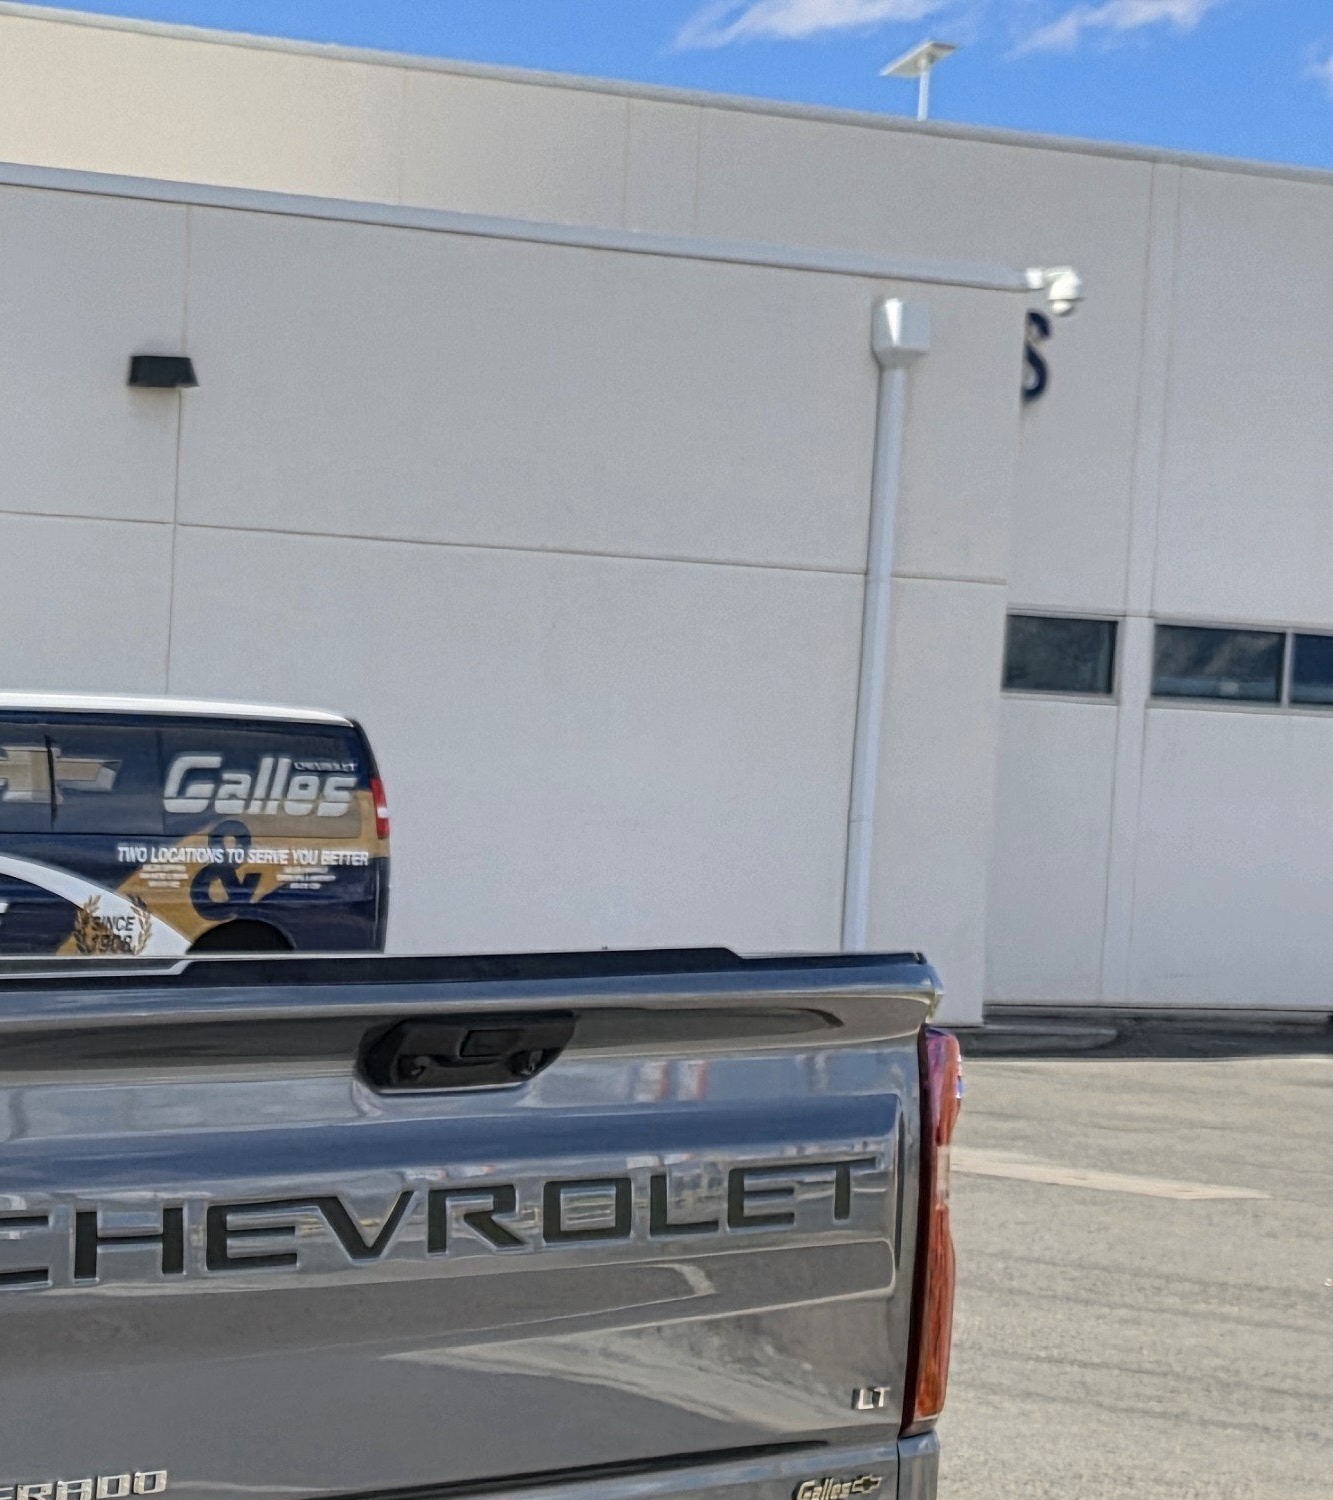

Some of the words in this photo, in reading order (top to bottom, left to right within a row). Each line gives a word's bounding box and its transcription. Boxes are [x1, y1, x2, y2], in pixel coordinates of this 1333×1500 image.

[163, 755, 358, 817] Galles
[118, 846, 148, 862] TWO
[150, 846, 224, 864] LOCATIONS
[227, 848, 244, 864] TO
[247, 848, 289, 865] SERVE
[292, 849, 319, 865] YOU
[321, 850, 369, 866] BETTER
[854, 1385, 891, 1411] LT
